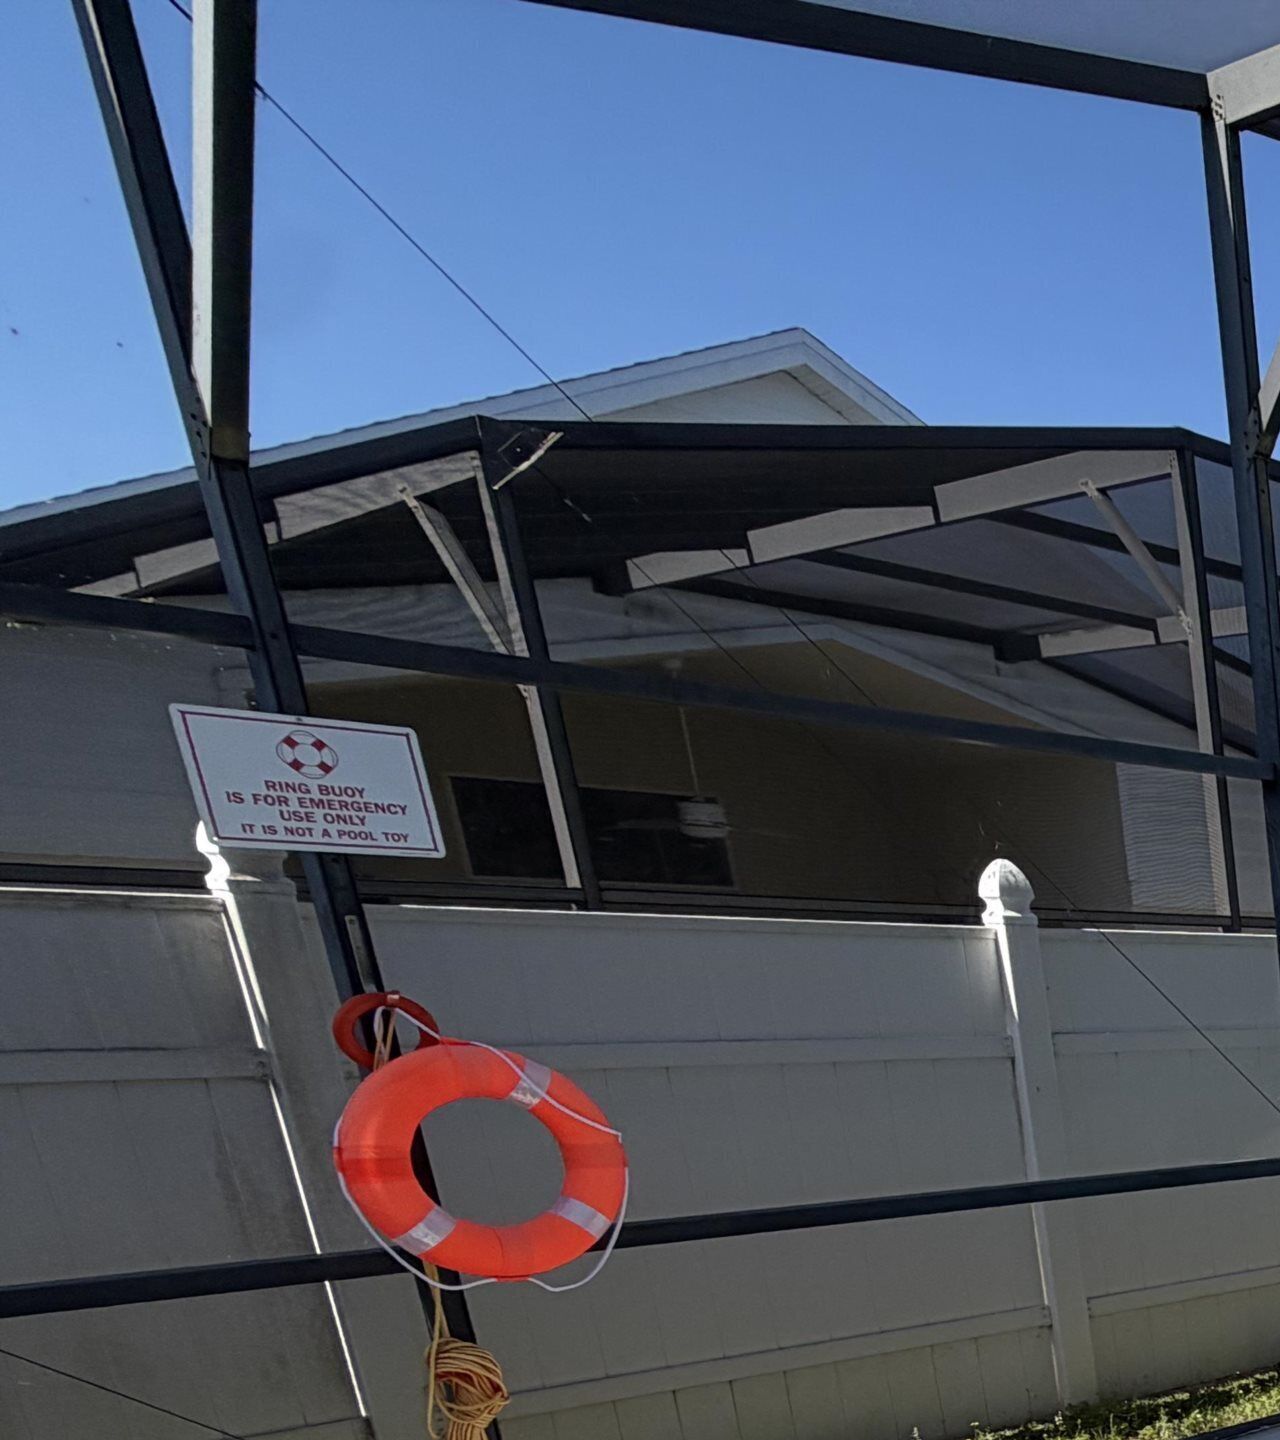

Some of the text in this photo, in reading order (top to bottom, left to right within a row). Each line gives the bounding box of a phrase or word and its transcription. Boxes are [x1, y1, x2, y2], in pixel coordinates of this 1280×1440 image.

[264, 780, 365, 799] RING BUOY
[225, 791, 407, 815] IS FOR EMERGENCY
[279, 809, 367, 826] USE ONLY
[241, 823, 409, 843] IT IS NOT A POOL TOY
